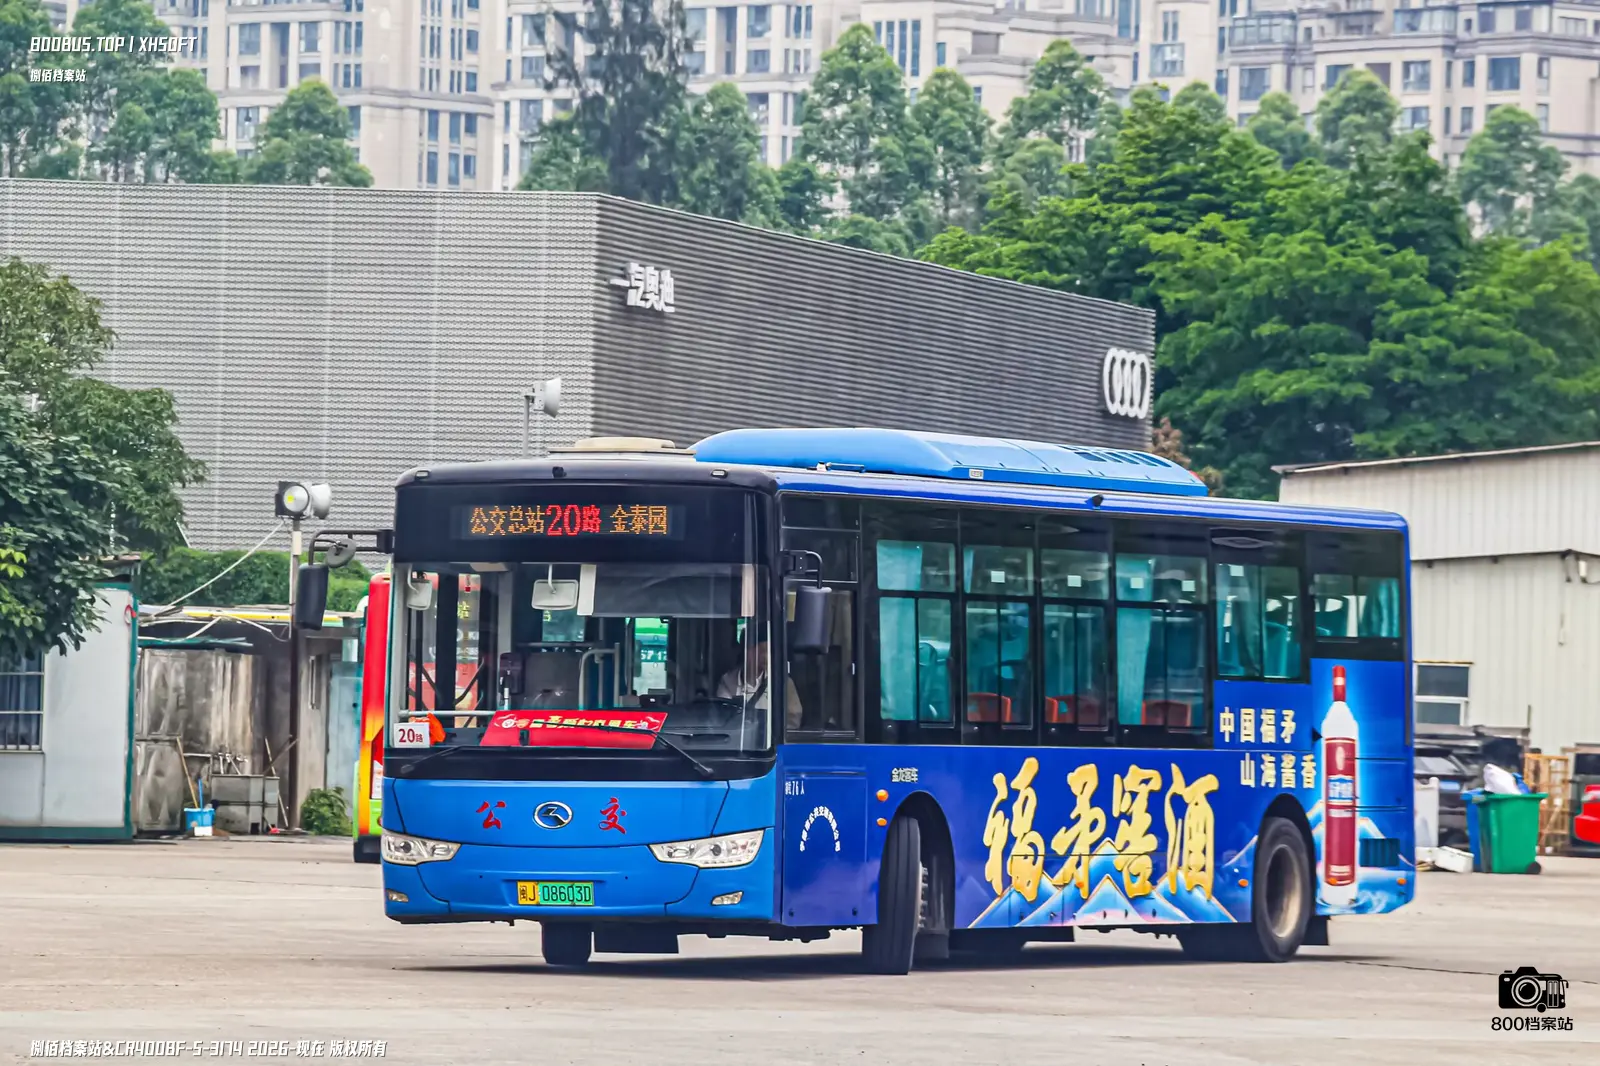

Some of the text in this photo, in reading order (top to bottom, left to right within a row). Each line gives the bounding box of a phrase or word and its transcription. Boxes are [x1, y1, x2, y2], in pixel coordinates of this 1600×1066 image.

[609, 262, 676, 313] 一汽奥迪
[1220, 706, 1297, 744] 中国福矛
[1240, 752, 1317, 789] 山海酱香
